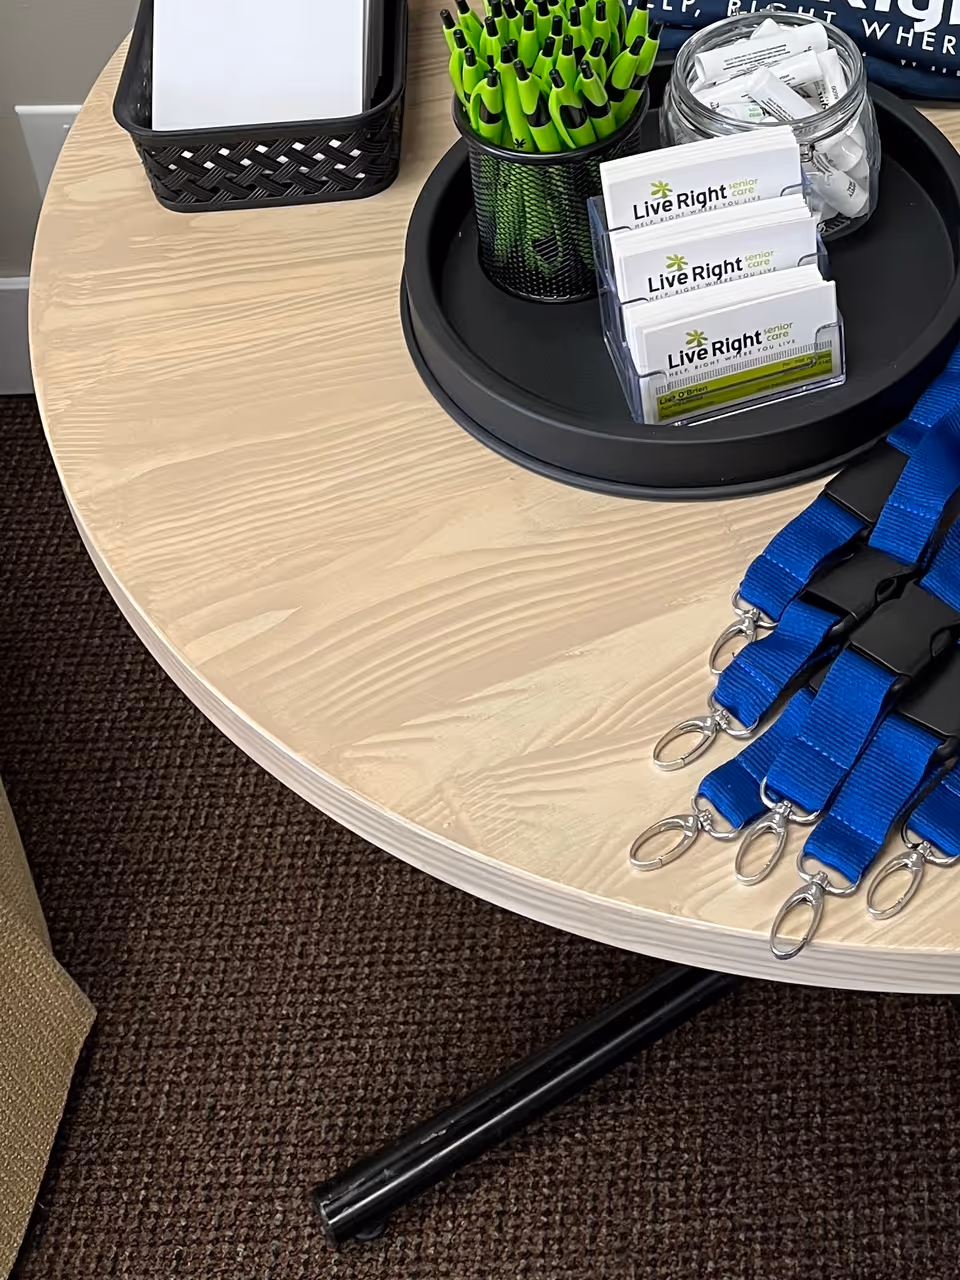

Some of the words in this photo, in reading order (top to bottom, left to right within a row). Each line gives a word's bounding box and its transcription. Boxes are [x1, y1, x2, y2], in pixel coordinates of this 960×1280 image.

[728, 178, 759, 190] senior
[731, 187, 755, 198] care
[676, 184, 728, 210] Right
[632, 198, 674, 221] Live
[744, 250, 775, 262] senior
[747, 258, 770, 269] care
[692, 257, 743, 282] Right
[647, 271, 689, 293] Live
[763, 322, 794, 336] senior
[766, 330, 790, 342] care
[711, 330, 762, 357] Right
[667, 347, 709, 370] Live
